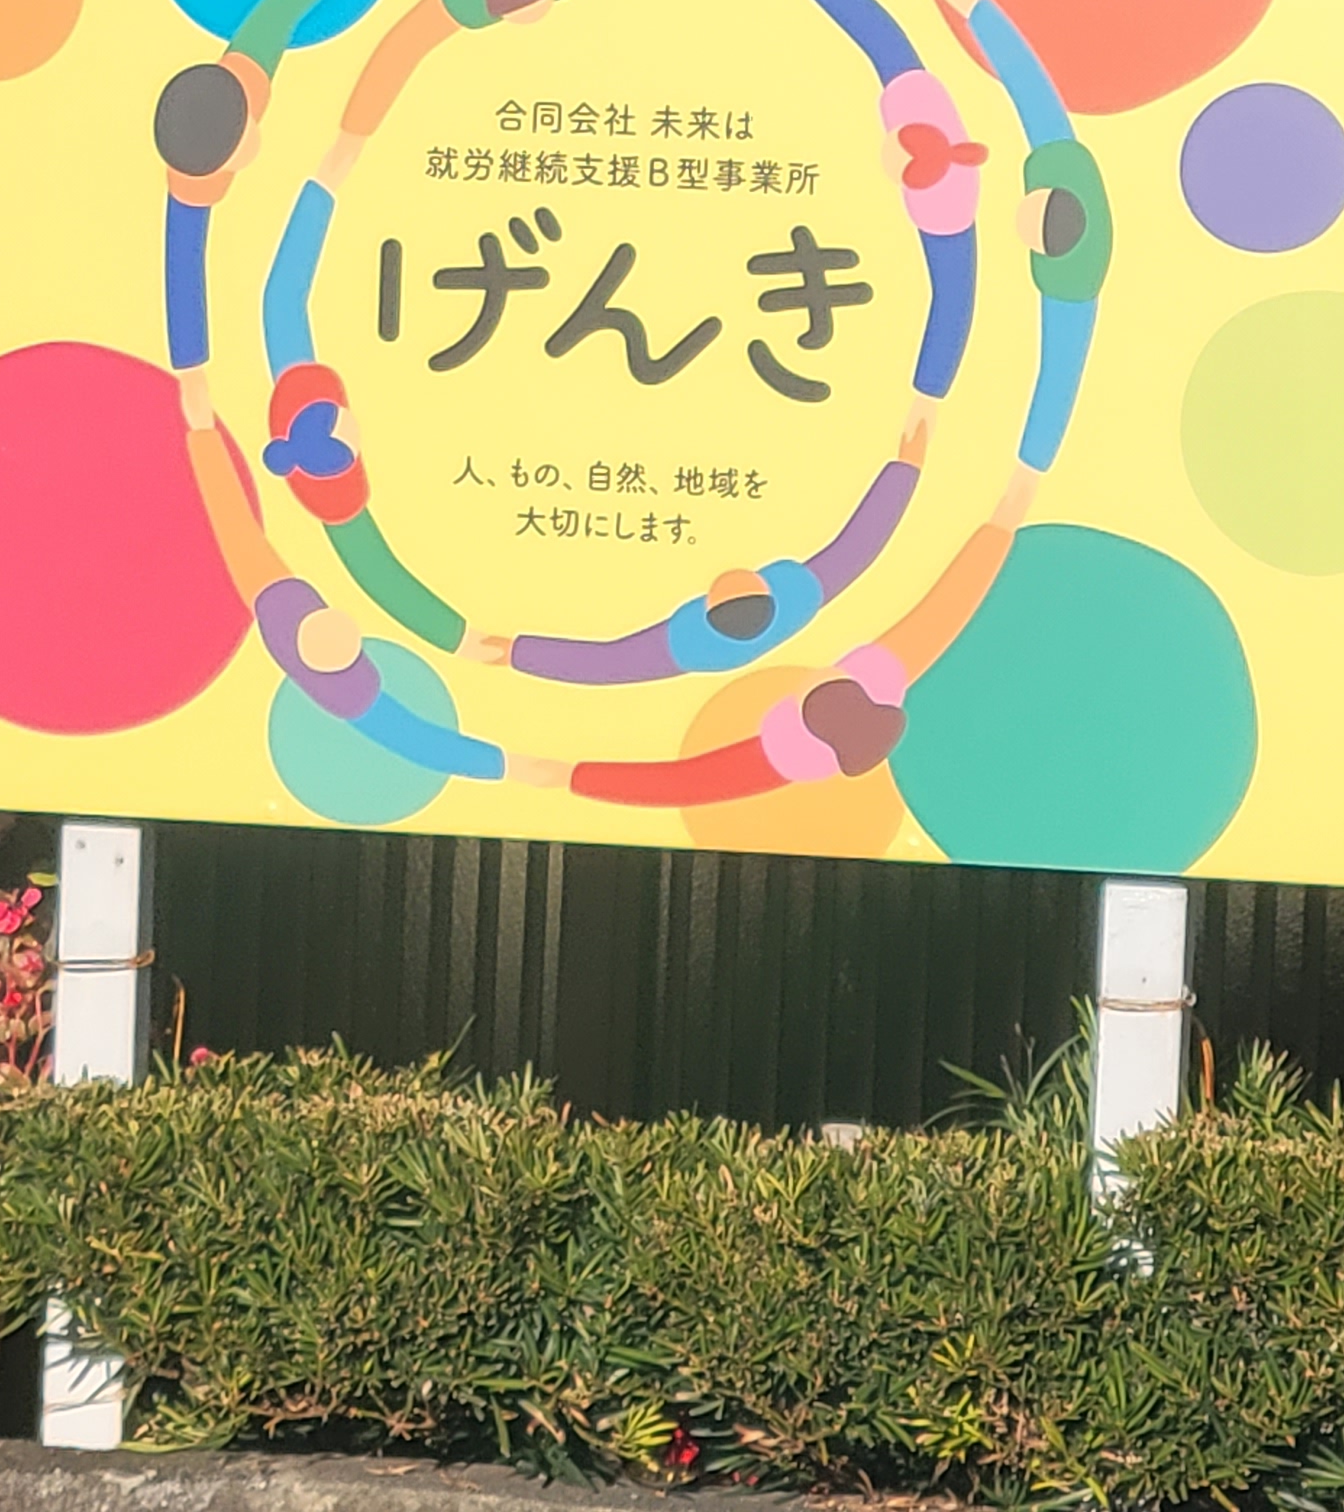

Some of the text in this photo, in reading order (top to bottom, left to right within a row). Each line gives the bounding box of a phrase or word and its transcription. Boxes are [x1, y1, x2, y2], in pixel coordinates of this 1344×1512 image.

[494, 98, 755, 142] 合同会社 未来は
[424, 145, 821, 197] 就労継続支援B型事業所
[378, 206, 873, 403] げんき
[451, 455, 769, 501] 人、もの、自然、地域を
[514, 504, 697, 546] 大切にします。
